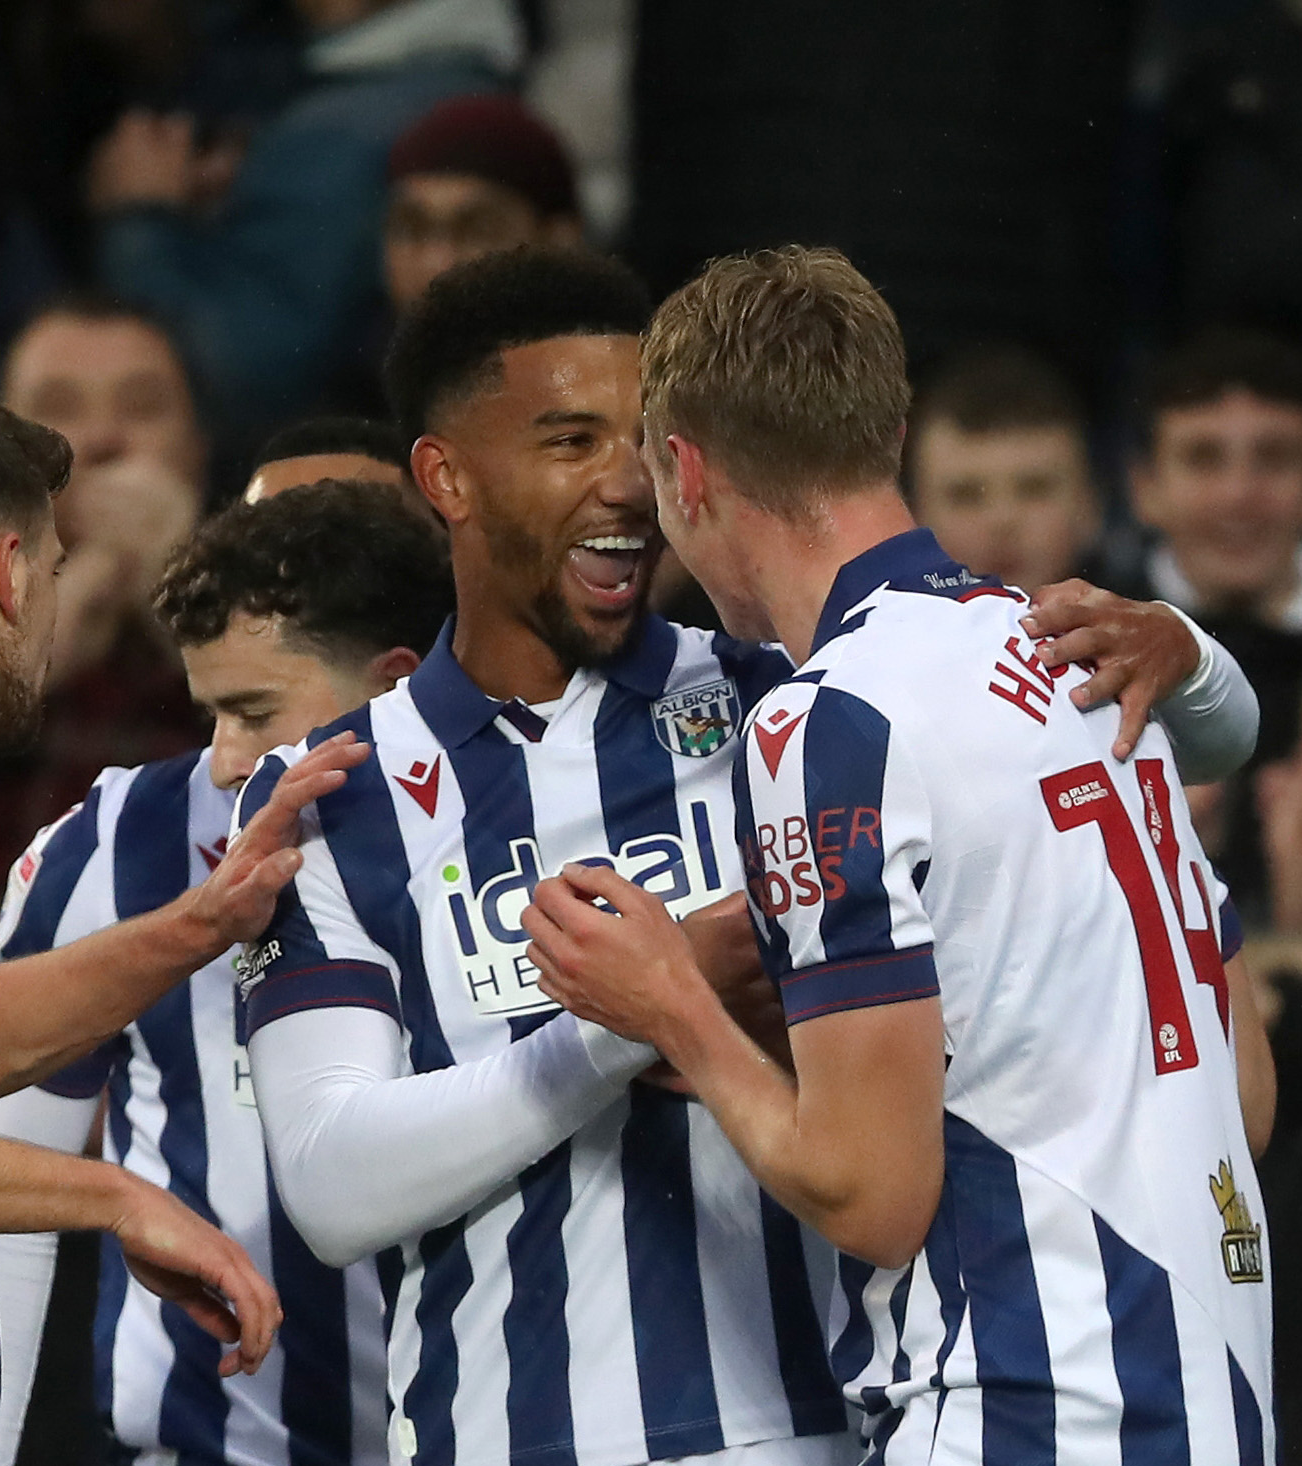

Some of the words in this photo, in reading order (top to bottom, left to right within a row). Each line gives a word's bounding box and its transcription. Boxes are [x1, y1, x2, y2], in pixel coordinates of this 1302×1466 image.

[658, 686, 731, 716] ALBION
[1039, 758, 1230, 1075] 14
[1164, 1050, 1183, 1064] EFL
